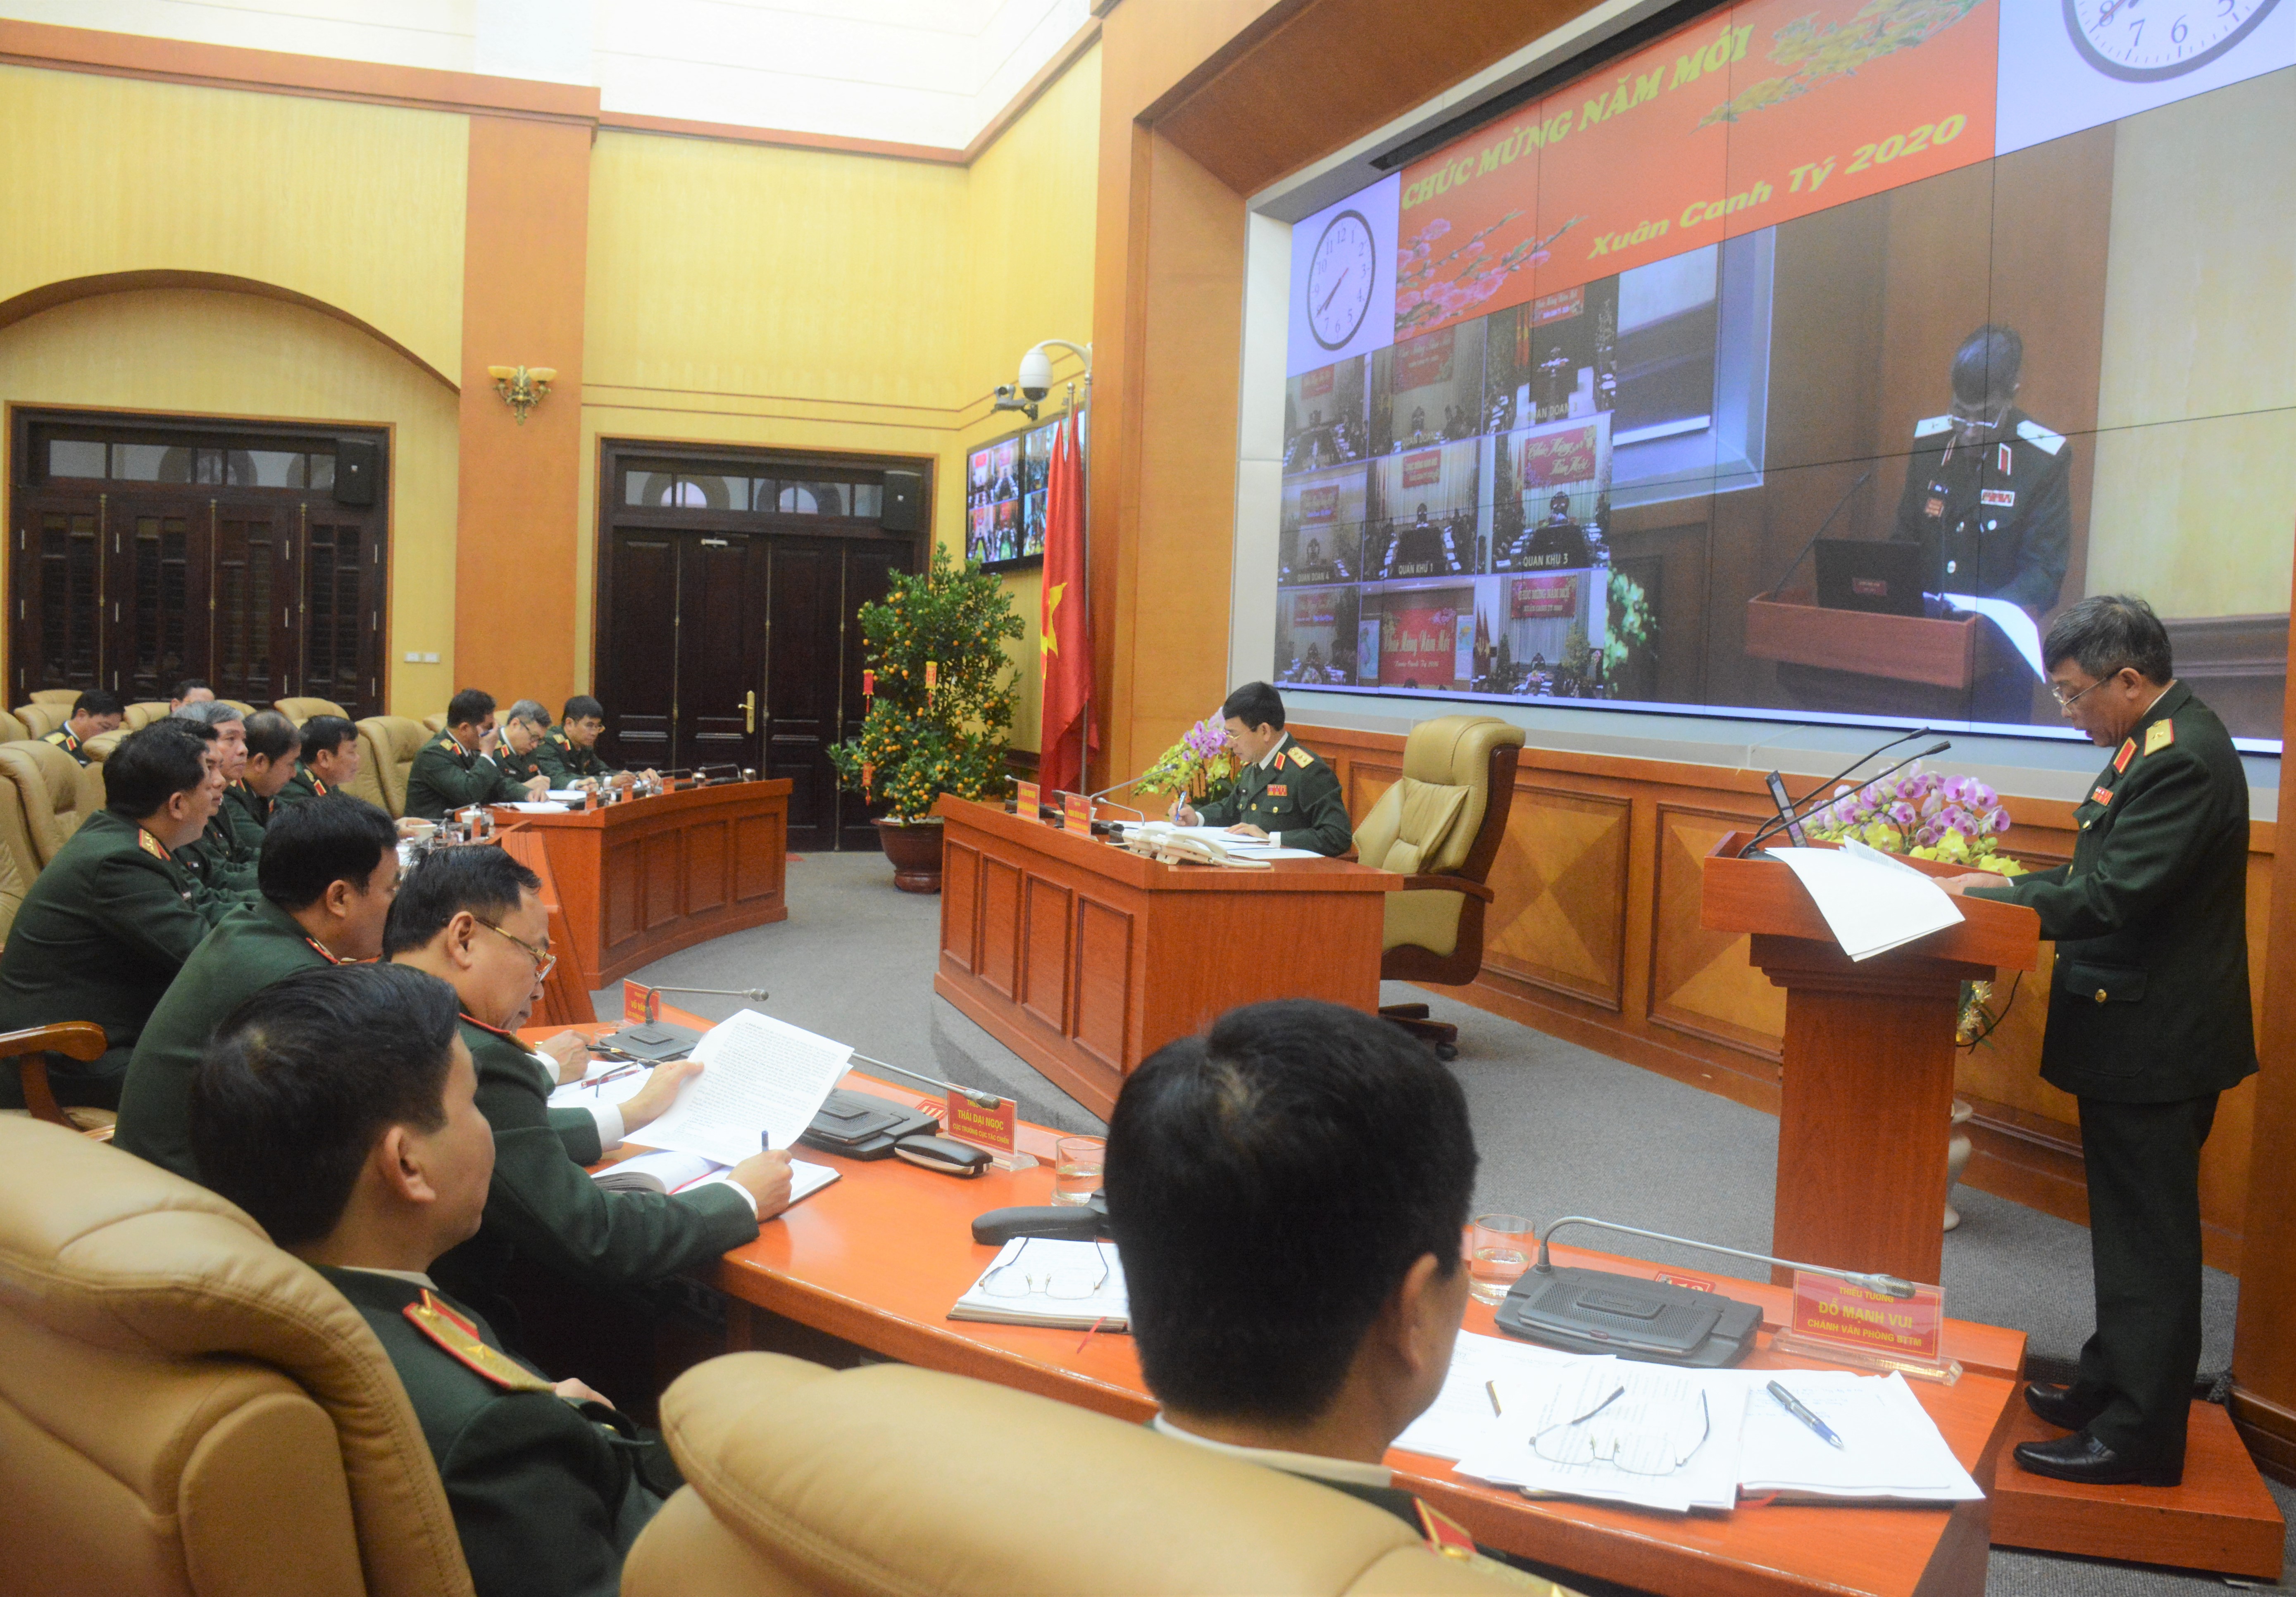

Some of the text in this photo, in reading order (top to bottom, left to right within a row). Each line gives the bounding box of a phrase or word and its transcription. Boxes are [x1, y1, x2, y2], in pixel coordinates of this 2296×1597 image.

[2129, 19, 2145, 47] 7
[2171, 14, 2188, 43] 6
[1402, 24, 1755, 210] CHÚC MỪNG NĂM MỚI
[1586, 114, 1967, 260] Xuân Canh Tý 2020
[1337, 227, 1346, 244] 12
[1562, 553, 1568, 564] 3
[986, 1117, 1004, 1131] NGỌC
[1843, 1305, 1884, 1324] MẠNH
[1889, 1313, 1913, 1329] VUI
[1841, 1324, 1860, 1336] VĂN
[1897, 1335, 1922, 1347] BTTM
